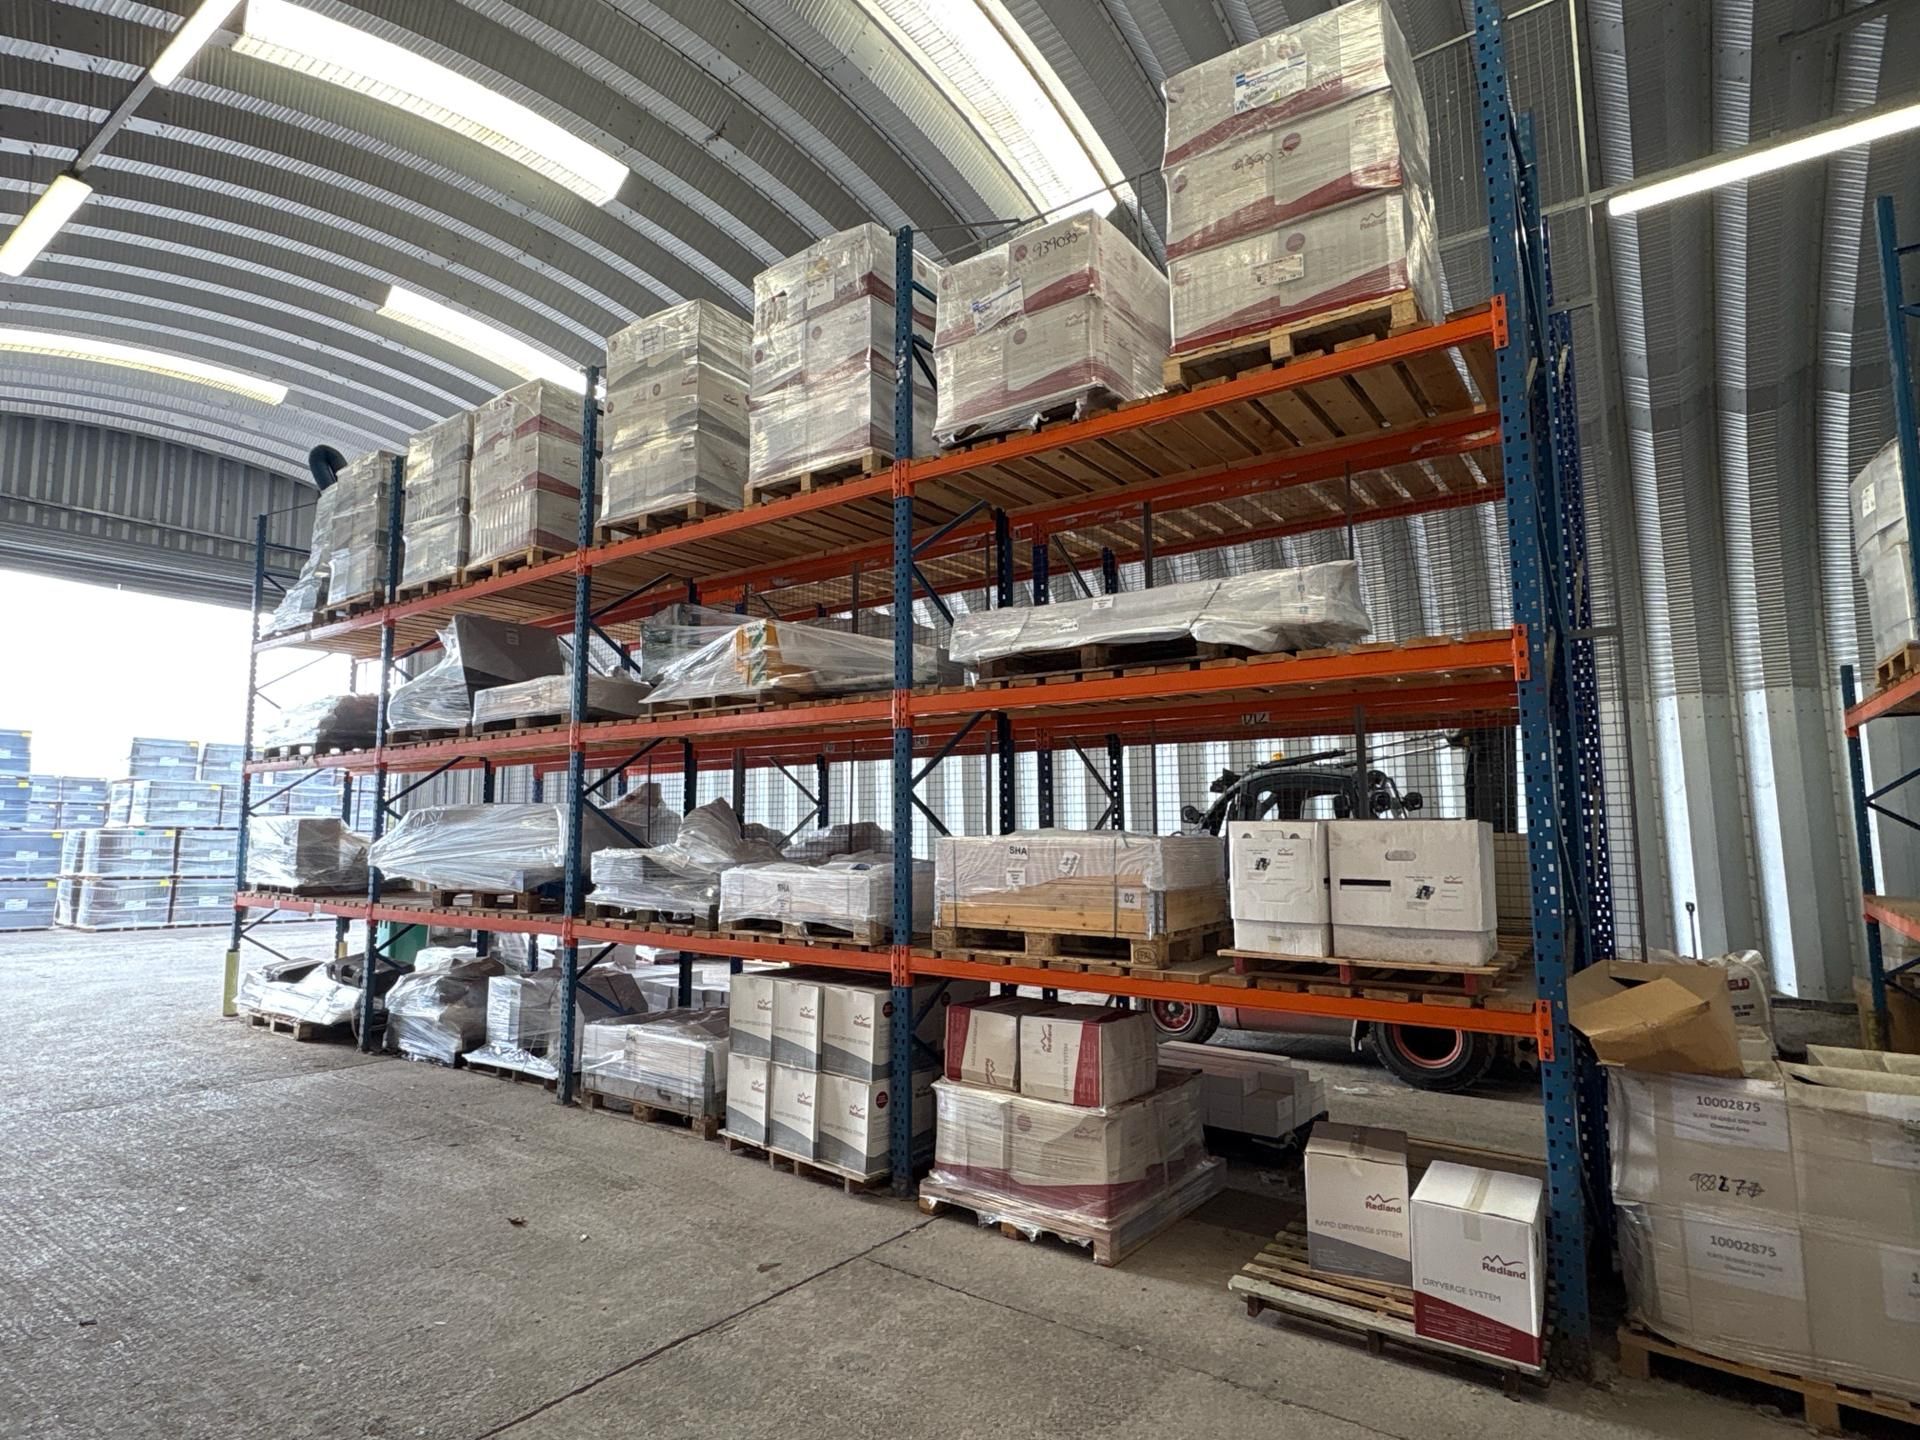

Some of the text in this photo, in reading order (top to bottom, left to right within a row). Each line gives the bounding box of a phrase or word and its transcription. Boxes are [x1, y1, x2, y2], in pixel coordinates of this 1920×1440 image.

[1009, 846, 1028, 856] SHA
[1124, 893, 1135, 904] 02
[1696, 1095, 1761, 1113] 10002875
[1365, 1201, 1402, 1214] Redland
[1376, 1228, 1403, 1239] SYSTEM
[1709, 1235, 1777, 1258] 10002875
[1482, 1262, 1527, 1280] Redland
[1422, 1278, 1502, 1303] DRYVERGE SYSTEM
